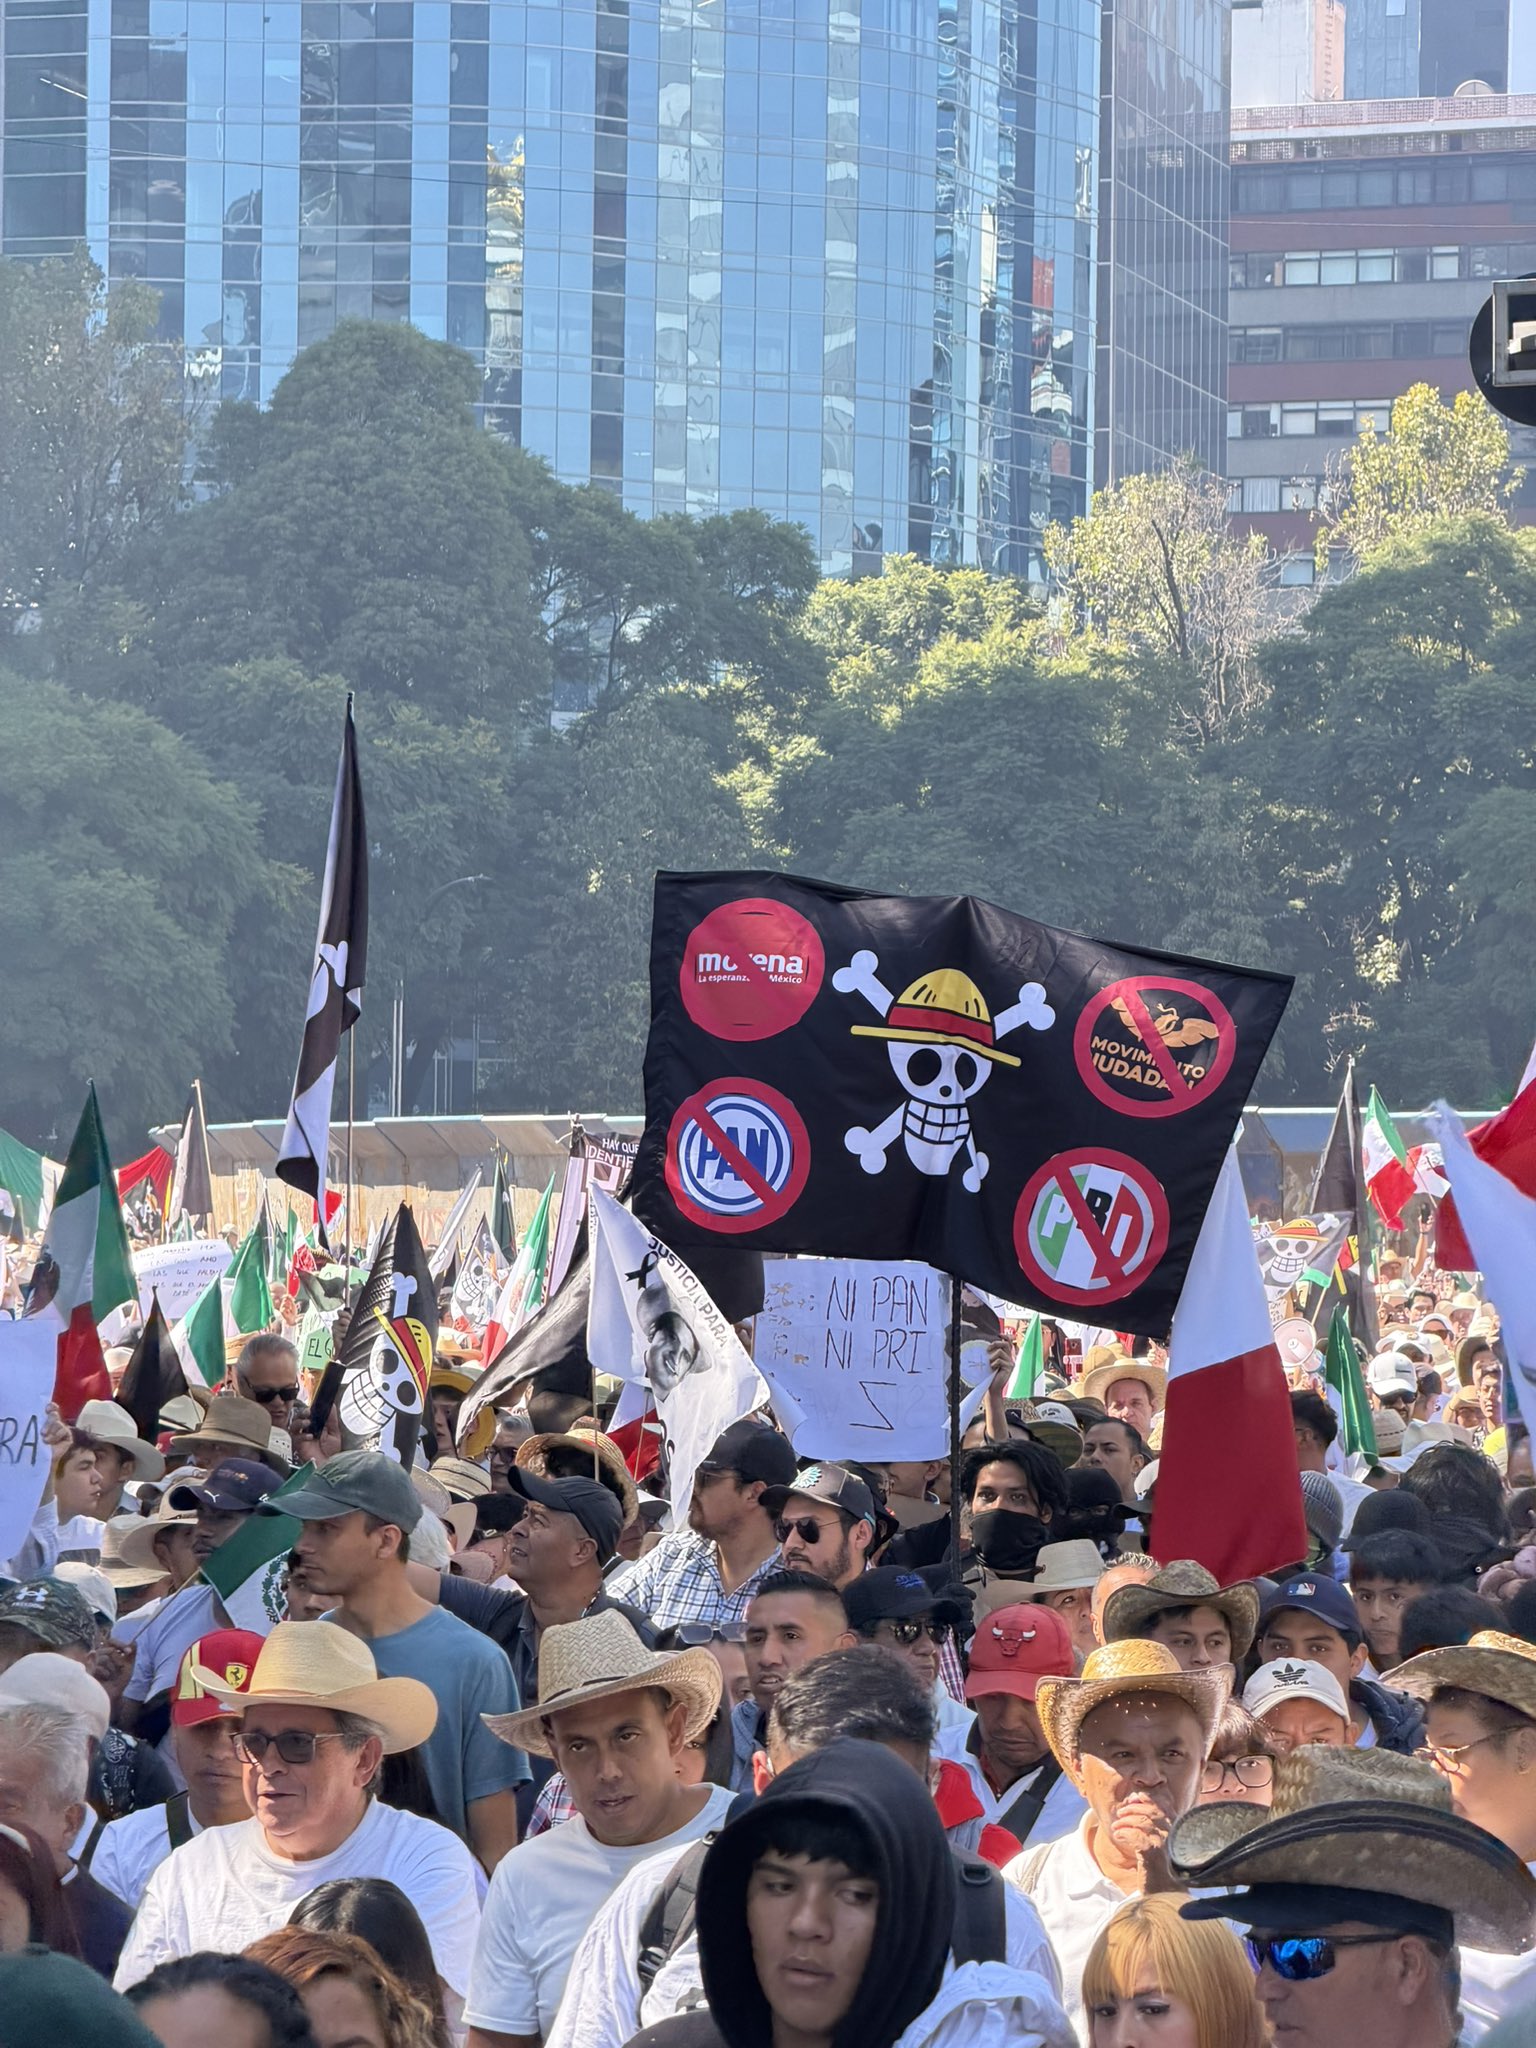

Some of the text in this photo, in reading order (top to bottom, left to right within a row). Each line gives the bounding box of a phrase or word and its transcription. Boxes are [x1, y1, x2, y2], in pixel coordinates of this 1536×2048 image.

[698, 953, 804, 974] moena
[698, 975, 707, 983] La
[708, 974, 751, 983] esperanz
[585, 1144, 636, 1169] IDENTIF
[602, 1138, 620, 1152] HAY
[697, 1126, 769, 1181] PAN
[1040, 1187, 1133, 1258] PRI
[827, 1276, 857, 1322] NI
[872, 1275, 928, 1326] PAN
[698, 1302, 729, 1348] PARA
[308, 1338, 322, 1358] EL
[825, 1328, 927, 1374] NI PRI
